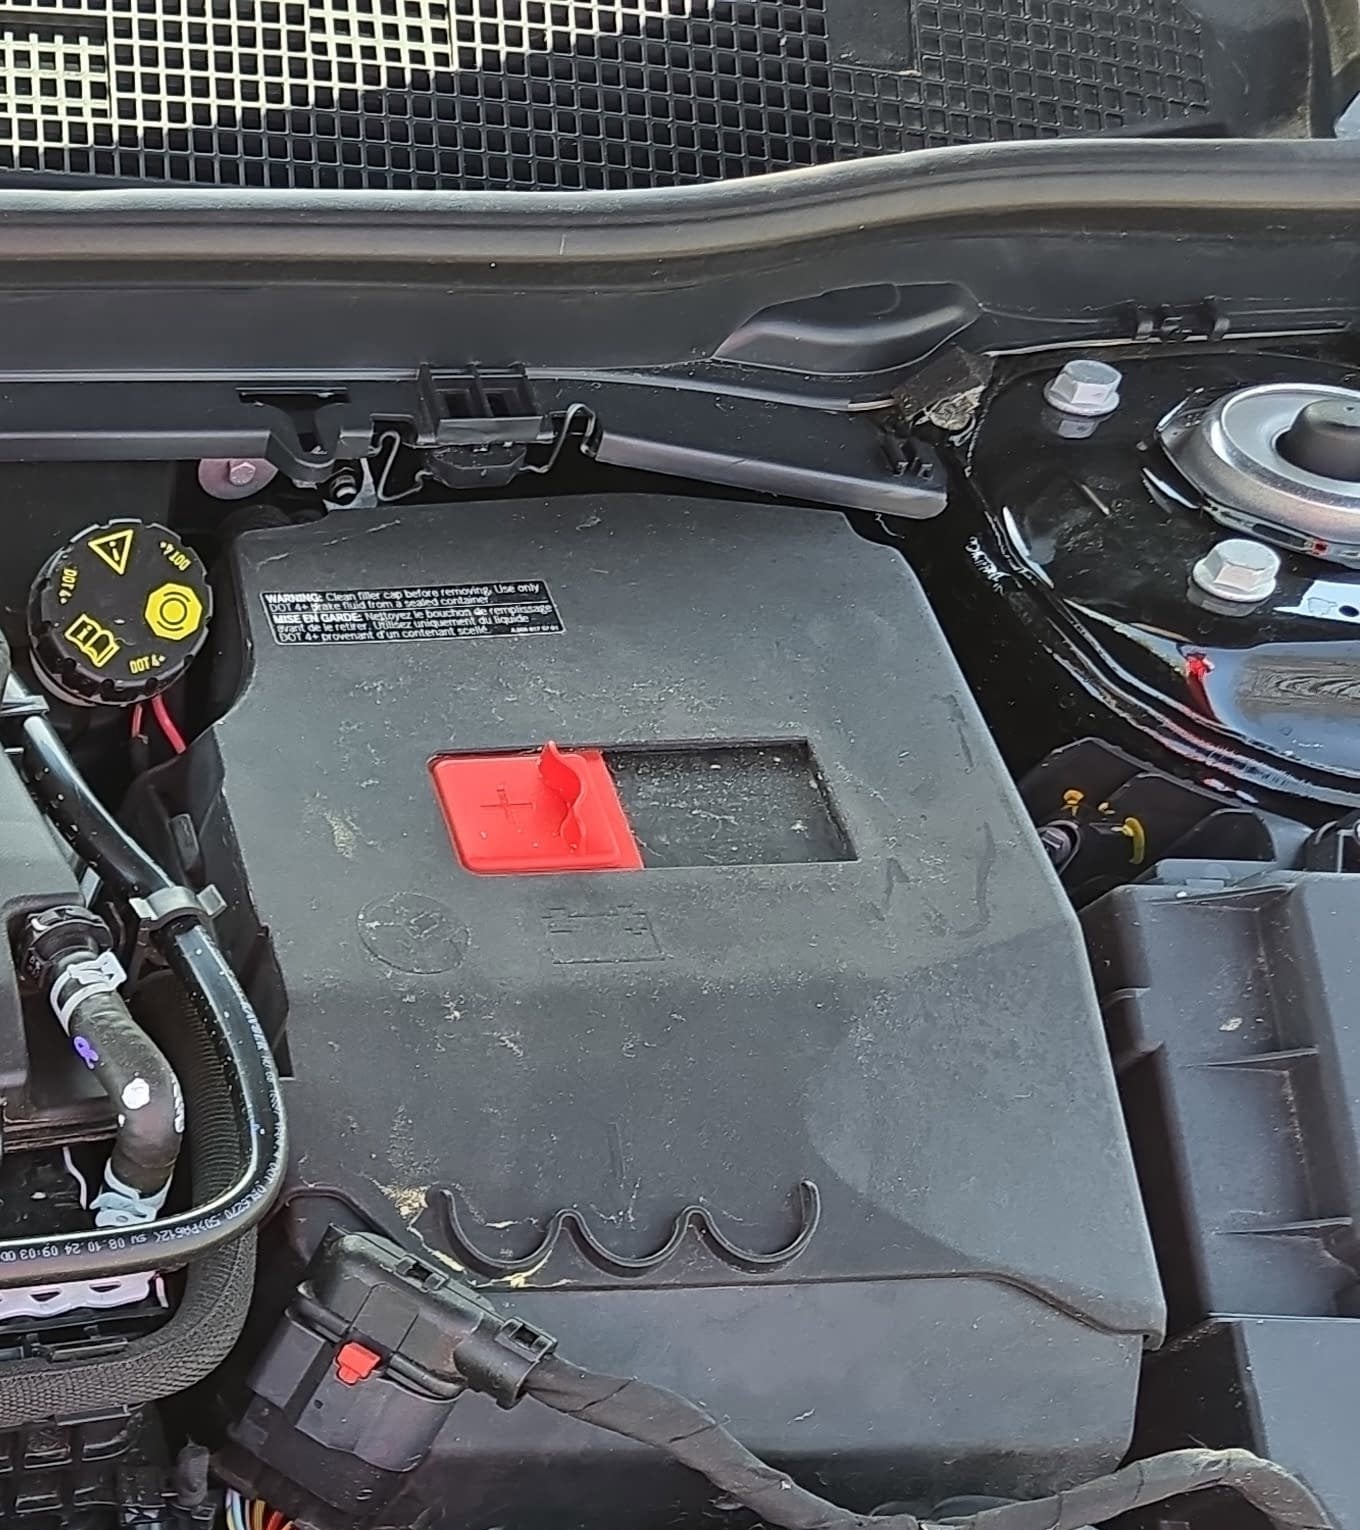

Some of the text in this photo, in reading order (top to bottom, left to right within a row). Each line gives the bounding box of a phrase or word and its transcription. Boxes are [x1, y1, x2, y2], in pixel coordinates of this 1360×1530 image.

[169, 550, 191, 571] DOT
[61, 568, 78, 591] DOT
[325, 592, 355, 601] Clean
[358, 590, 380, 600] filler
[383, 590, 403, 601] cap
[404, 588, 438, 599] before
[493, 584, 515, 594] Use
[517, 583, 539, 593] only
[269, 603, 291, 613] DOT
[294, 603, 309, 611] 4+
[343, 600, 366, 609] fluid
[368, 600, 393, 609] from
[404, 597, 438, 607] sealed
[272, 614, 302, 624] MISE
[303, 613, 319, 623] EN
[364, 611, 411, 622] Nettoyez
[413, 610, 424, 619] le
[425, 608, 472, 618] bouchon
[473, 606, 488, 616] de
[489, 604, 553, 615] remplissage
[307, 623, 322, 632] de
[324, 623, 334, 632] le
[372, 620, 411, 630] Utilisez
[413, 617, 477, 628] uniquement
[478, 615, 492, 625] du
[494, 614, 529, 625] liquide
[279, 632, 302, 642] DOT
[304, 632, 319, 641] 4+
[321, 631, 374, 642] provenant
[376, 629, 400, 639] d'un
[401, 627, 456, 639] contenant
[129, 657, 150, 673] DOT
